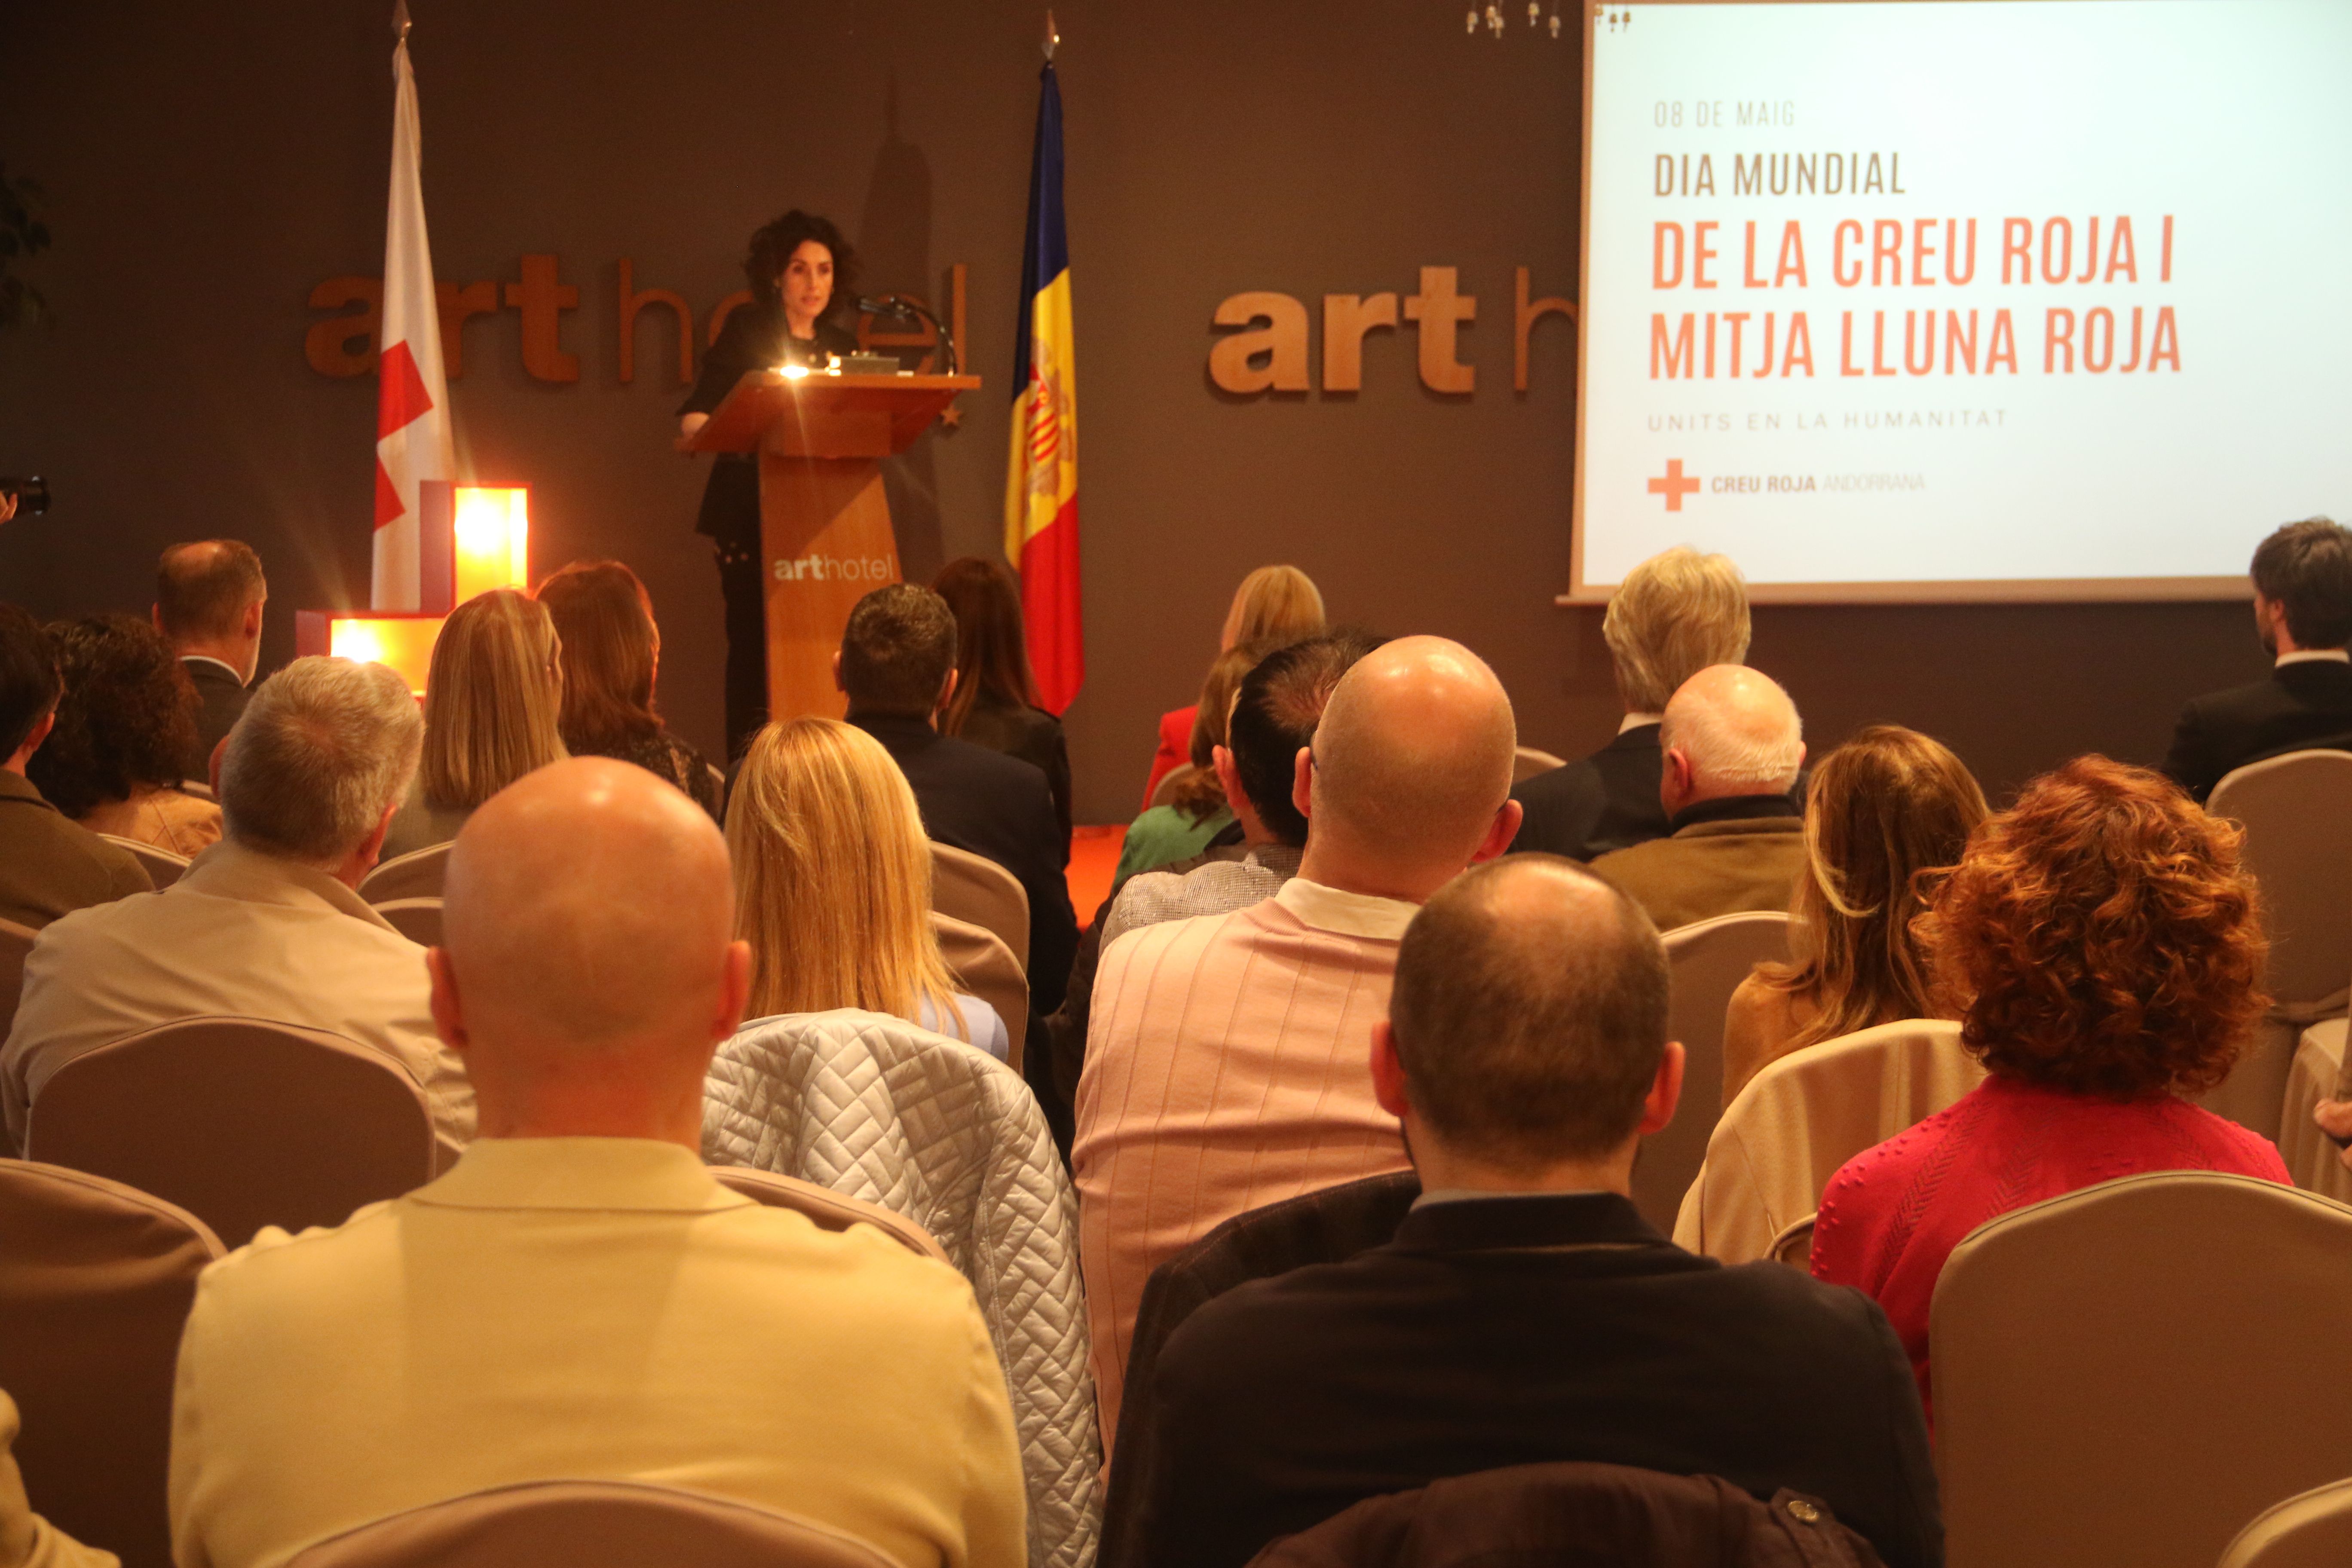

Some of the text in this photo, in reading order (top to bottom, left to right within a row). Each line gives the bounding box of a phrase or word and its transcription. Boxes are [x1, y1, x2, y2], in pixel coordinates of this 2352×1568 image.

[1654, 100, 1795, 128] 08 DE MAIG
[1654, 151, 1906, 197] DIA MUNDIAL
[1653, 214, 2174, 290] DE LA CREU ROJA I
[1650, 311, 1815, 380] MITJA
[1840, 308, 2018, 377] LLUNA
[2044, 306, 2182, 374] ROJA
[1648, 409, 2007, 432] UNITS EN LA HUMANITAT
[1711, 473, 1926, 494] CREU ROJA ANDORRANA
[775, 554, 894, 581] arthotel
